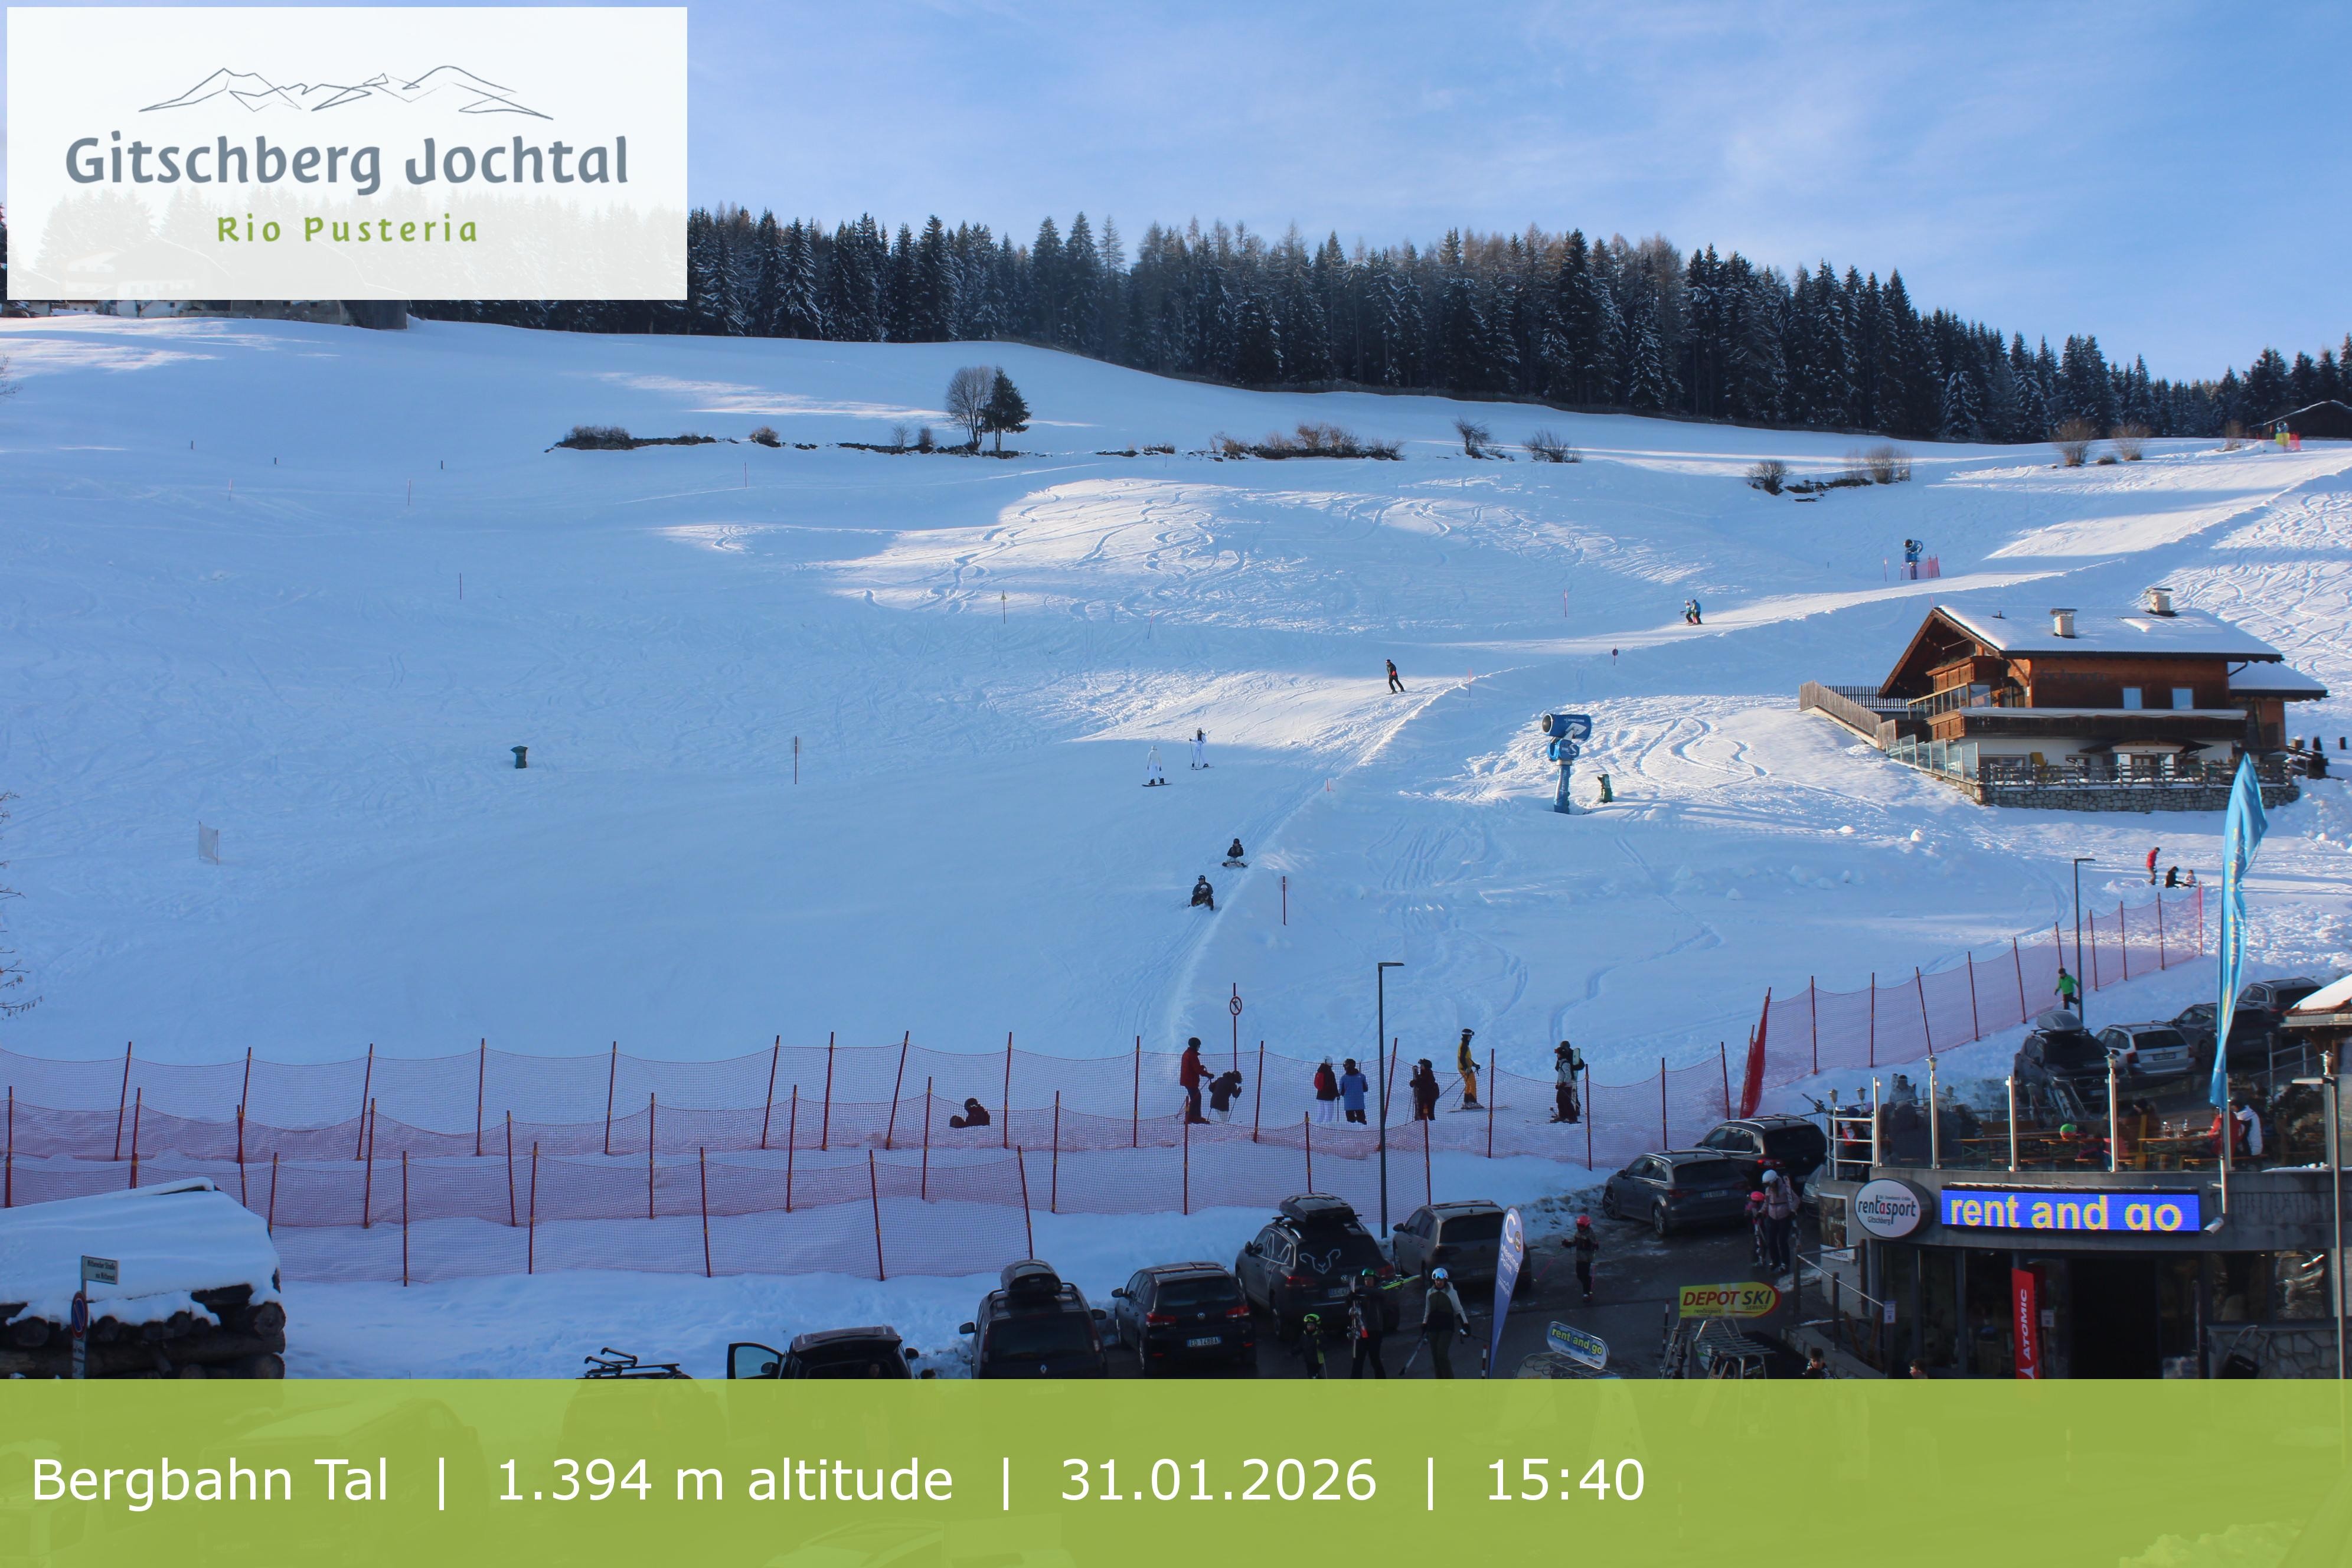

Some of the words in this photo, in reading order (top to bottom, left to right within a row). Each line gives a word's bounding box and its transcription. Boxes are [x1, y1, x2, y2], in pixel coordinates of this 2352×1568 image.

[1858, 1194, 1916, 1224] rentasport
[1867, 1216, 1890, 1226] Gitschberg
[1951, 1195, 2020, 1228] rent
[2031, 1195, 2108, 1230] and
[1501, 1243, 1519, 1273] Meeting
[1501, 1252, 1513, 1275] Point
[1683, 1291, 1740, 1306] DEPOT
[1742, 1290, 1772, 1305] SKI
[2020, 1288, 2031, 1361] ATOMIC
[1551, 1328, 1571, 1342] rent
[1572, 1336, 1590, 1350] and
[1590, 1344, 1603, 1355] go
